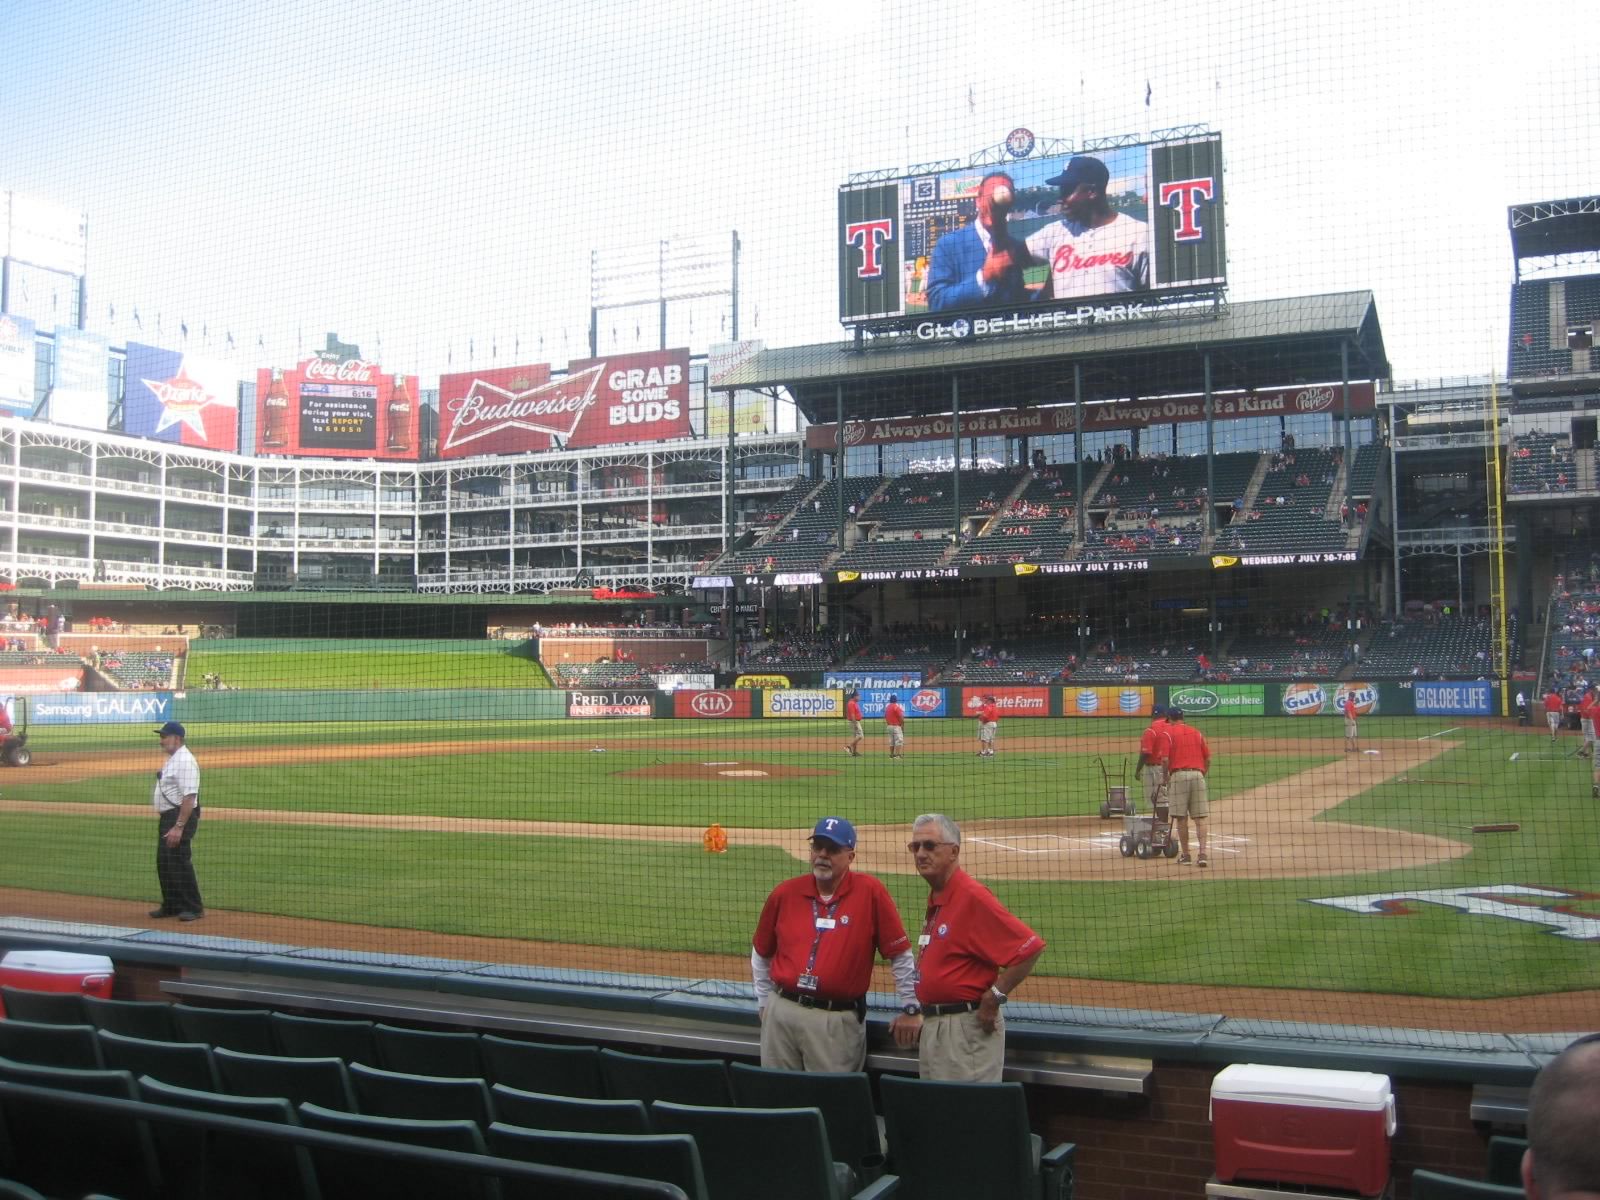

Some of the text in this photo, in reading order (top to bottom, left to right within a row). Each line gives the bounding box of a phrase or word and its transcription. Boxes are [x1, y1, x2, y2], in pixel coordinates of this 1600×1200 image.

[1159, 176, 1214, 242] T
[845, 218, 892, 280] T
[1053, 244, 1135, 272] Braves
[1013, 311, 1067, 333] LIFE
[1077, 302, 1144, 325] PARK
[609, 365, 682, 391] GRAB
[622, 386, 669, 403] SOME
[1300, 390, 1332, 410] Pepper
[1309, 387, 1323, 398] Dr
[303, 409, 329, 417] during
[326, 402, 368, 410] assistance
[447, 390, 598, 427] Budweiser
[609, 399, 681, 425] BUDS
[1096, 404, 1162, 424] Always
[1163, 402, 1200, 416] One
[1238, 394, 1285, 413] Kind
[332, 418, 364, 426] REPORT
[872, 422, 933, 440] Always
[968, 415, 986, 431] of
[988, 418, 998, 430] a
[1000, 411, 1042, 430] Kind
[1241, 555, 1296, 566] WEDNESDAY
[1298, 554, 1321, 564] JULY
[1323, 552, 1357, 562] 30-7:05
[861, 571, 897, 581] MONDAY
[900, 570, 922, 579] JULY
[925, 569, 959, 578] 28-7:05
[1040, 563, 1082, 574] TUESDAY
[1085, 562, 1109, 572] JULY
[1113, 561, 1149, 571] 29-7:05
[571, 691, 649, 705] FRED LOYA
[699, 696, 726, 710] KIA
[771, 693, 835, 716] Snapple
[916, 694, 937, 707] DQ
[1014, 696, 1044, 708] Farm
[1177, 694, 1213, 705] Scotts
[1221, 695, 1241, 705] used
[1285, 690, 1323, 709] Gulf
[1427, 687, 1488, 709] GLOBE LIFE
[36, 697, 168, 718] Samsung GALAXY
[571, 706, 649, 715] INSURANCE
[862, 703, 884, 714] STOP
[825, 818, 839, 831] T
